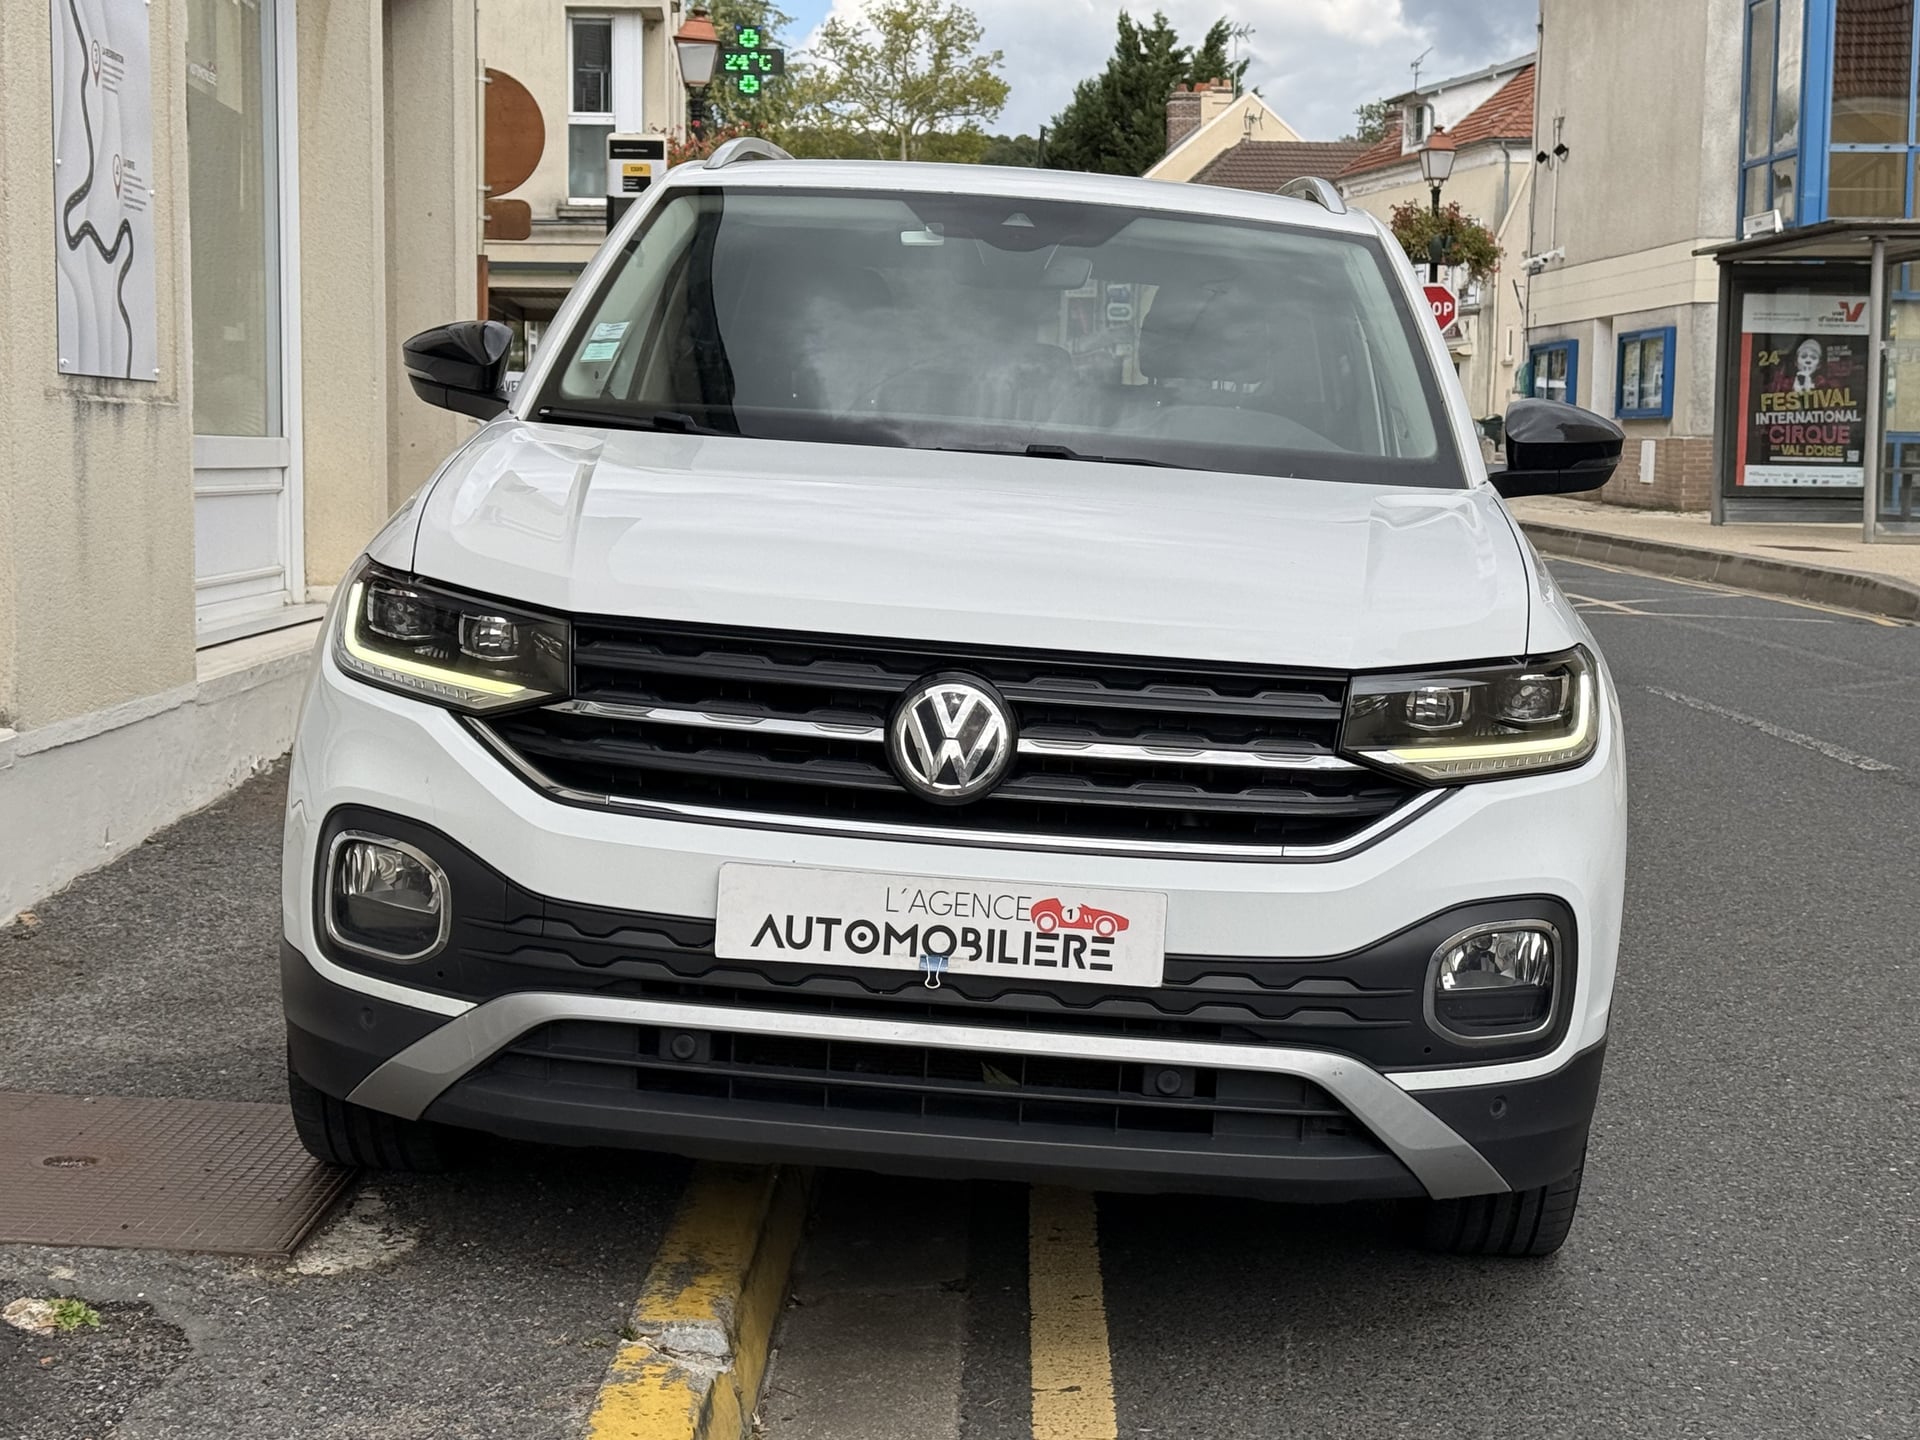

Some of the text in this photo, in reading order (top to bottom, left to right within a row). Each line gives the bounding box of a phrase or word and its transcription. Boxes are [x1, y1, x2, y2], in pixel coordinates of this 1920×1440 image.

[725, 51, 772, 70] 24°C
[1431, 301, 1453, 317] OP
[1760, 387, 1857, 412] FESTIVAL
[1755, 409, 1862, 425] INTERNATIONAL
[1769, 425, 1850, 445] CIRQUE
[1781, 444, 1803, 456] VAL
[750, 913, 1116, 972] AUTOMOBILIERE
